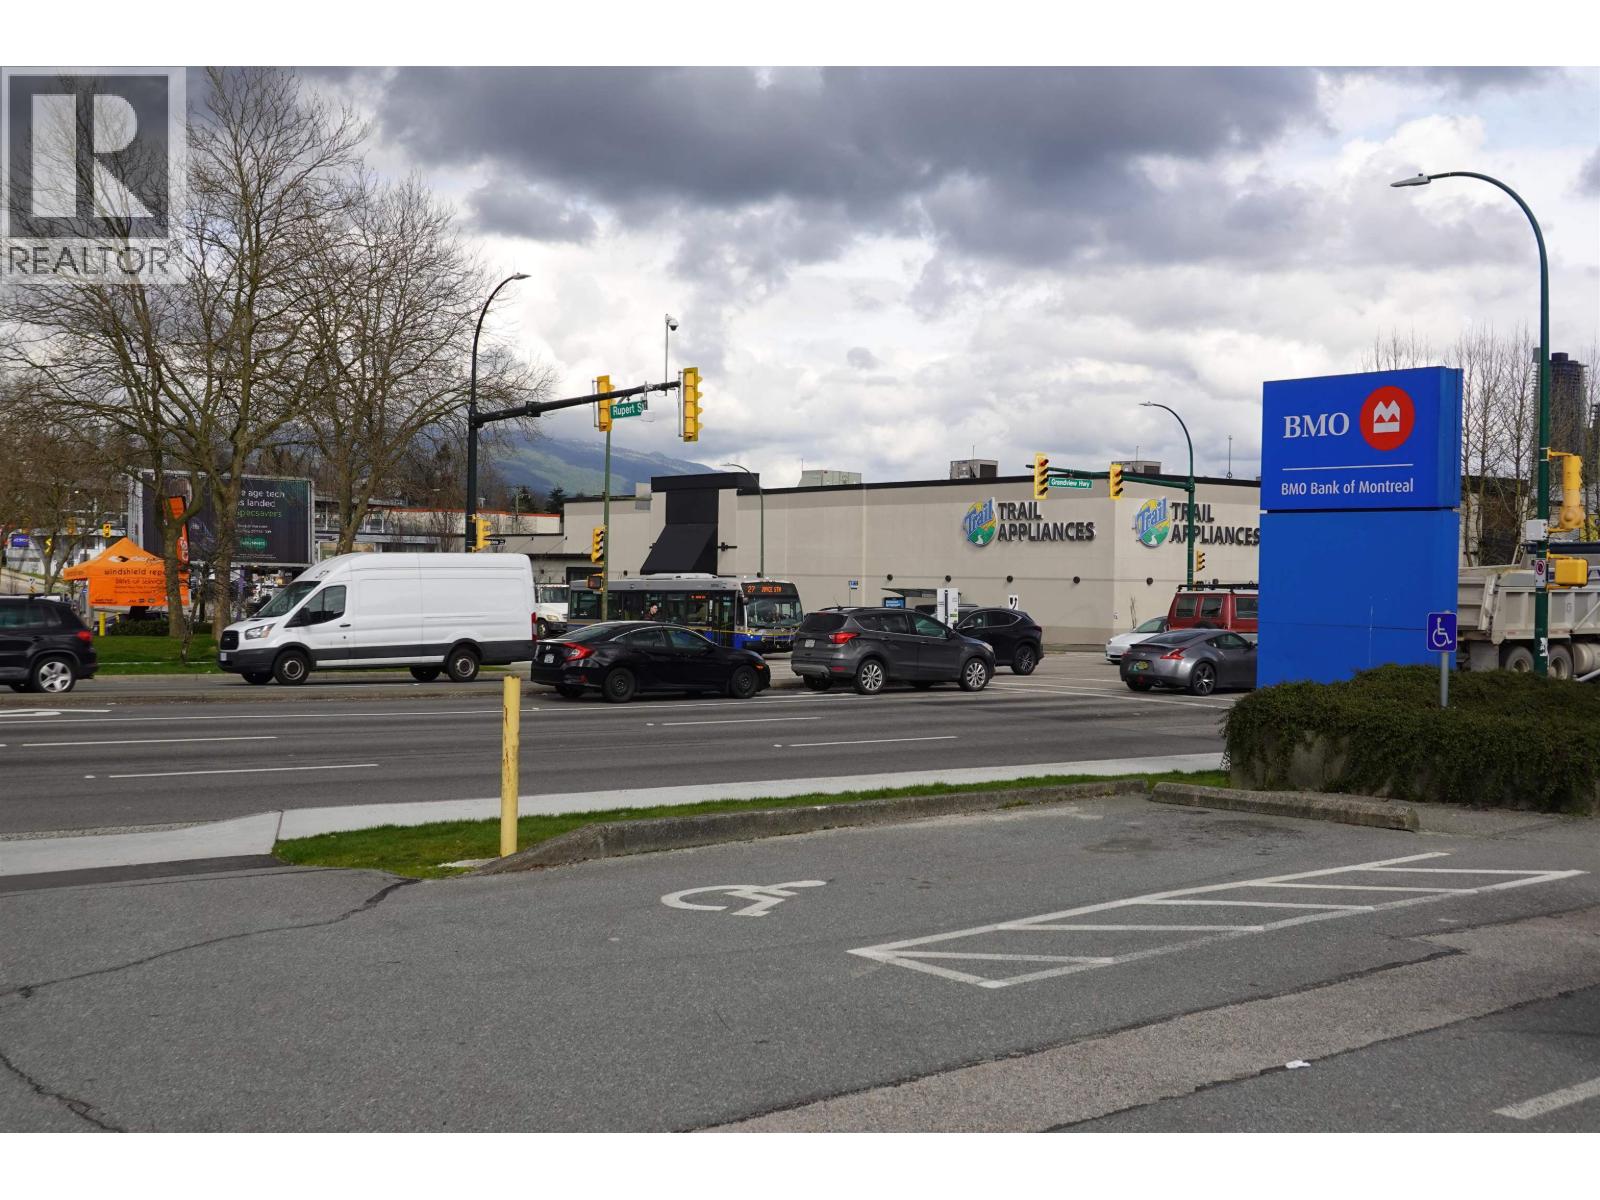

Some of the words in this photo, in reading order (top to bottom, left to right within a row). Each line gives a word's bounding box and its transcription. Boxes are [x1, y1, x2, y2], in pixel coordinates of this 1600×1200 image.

[613, 404, 635, 416] Rupert
[1283, 412, 1349, 438] BMO
[1051, 478, 1078, 487] Grandview
[1282, 482, 1307, 496] BMO
[1311, 480, 1339, 495] Bank
[1344, 479, 1355, 493] of
[1359, 477, 1413, 493] Montreal
[266, 490, 285, 498] tech
[963, 499, 993, 535] Trail
[998, 501, 1043, 520] TRAIL
[1136, 499, 1167, 536] Trail
[1170, 502, 1215, 522] TRAIL
[998, 522, 1095, 541] APPLIANCES
[1169, 524, 1260, 546] APPLIANCES
[104, 568, 147, 576] windshield
[149, 569, 165, 577] rep
